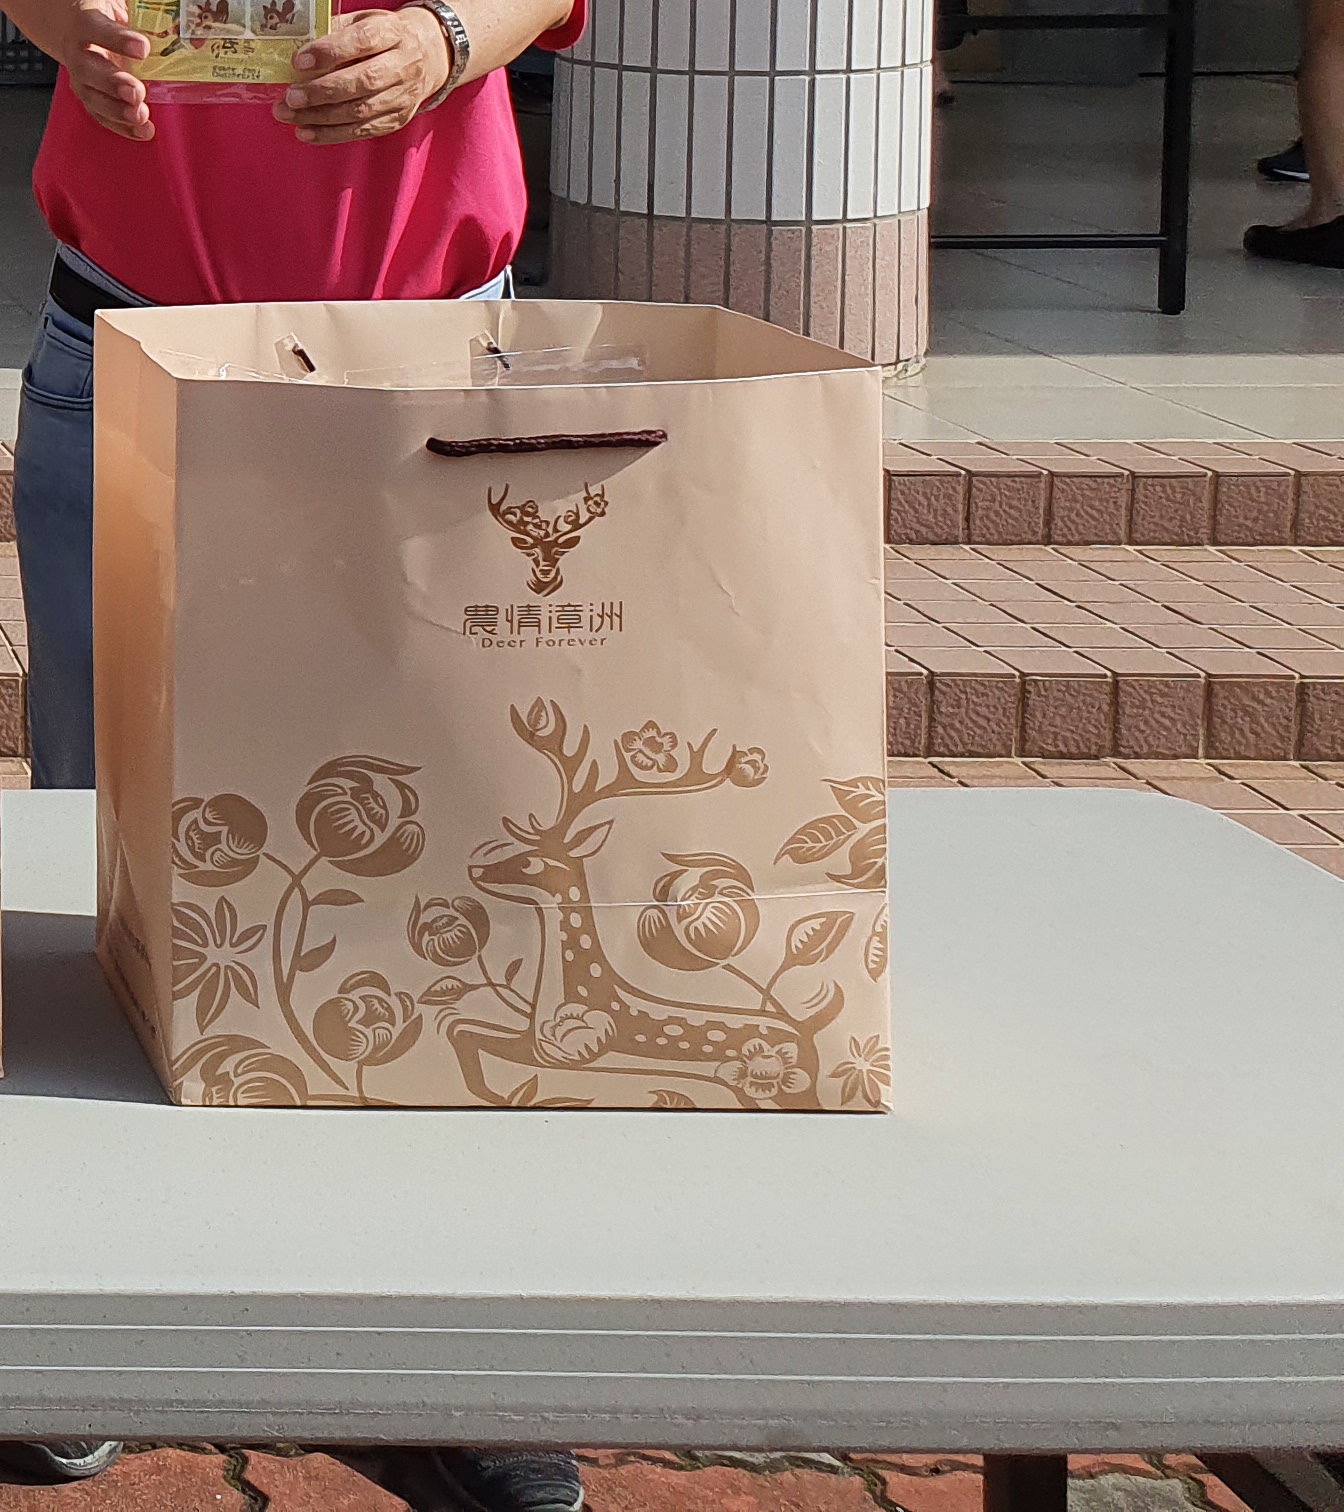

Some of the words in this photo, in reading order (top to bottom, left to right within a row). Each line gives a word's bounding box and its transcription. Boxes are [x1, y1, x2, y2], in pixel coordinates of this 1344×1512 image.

[461, 600, 625, 637] 農情漳洲
[481, 637, 527, 649] Deer
[535, 635, 608, 648] Forever
